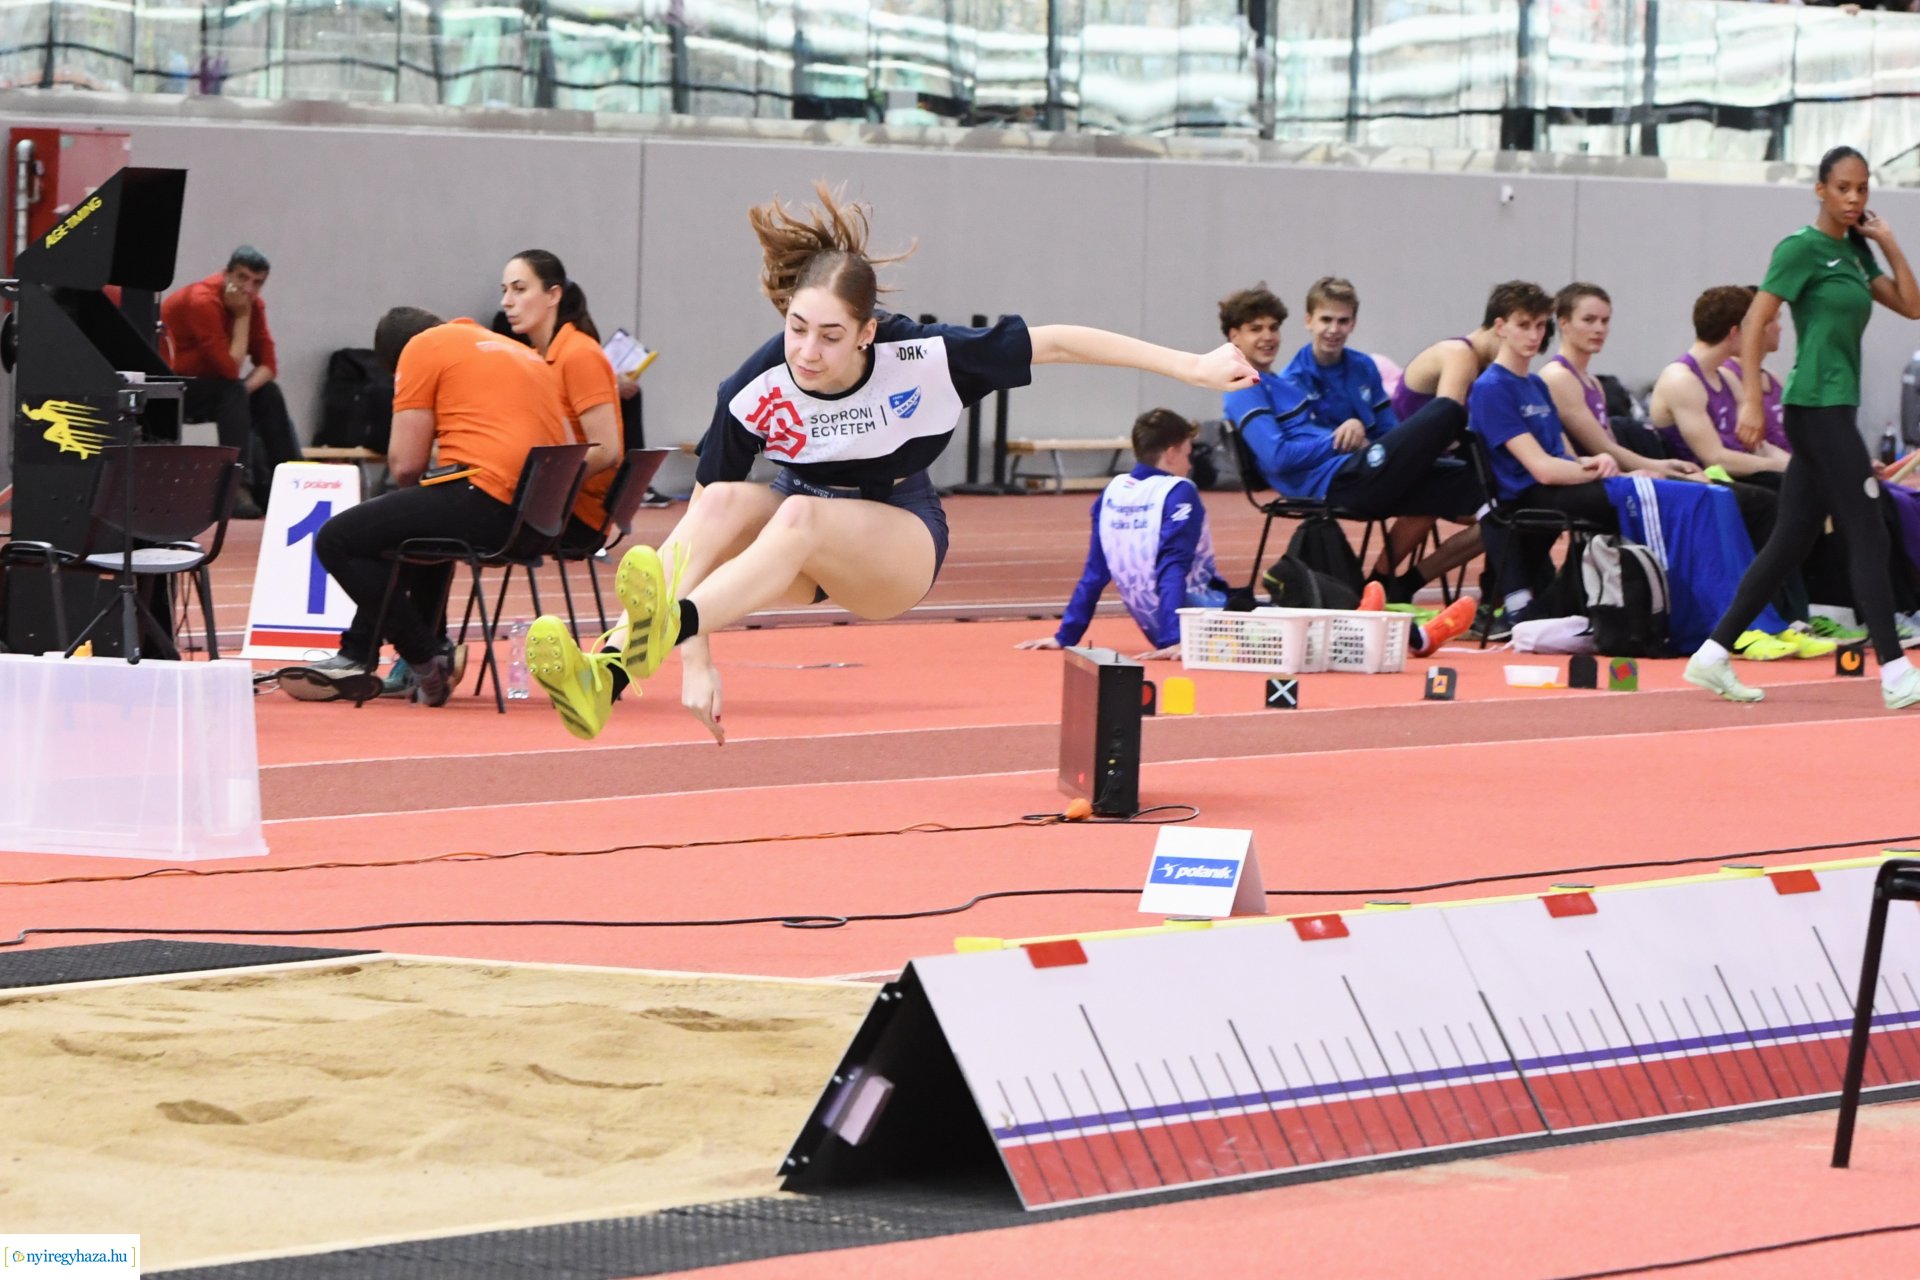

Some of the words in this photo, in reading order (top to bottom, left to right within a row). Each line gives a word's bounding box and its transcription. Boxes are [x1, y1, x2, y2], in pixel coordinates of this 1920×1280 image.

[810, 407, 873, 425] SOPRONI
[811, 421, 876, 438] EGYETEM
[286, 501, 332, 614] 1
